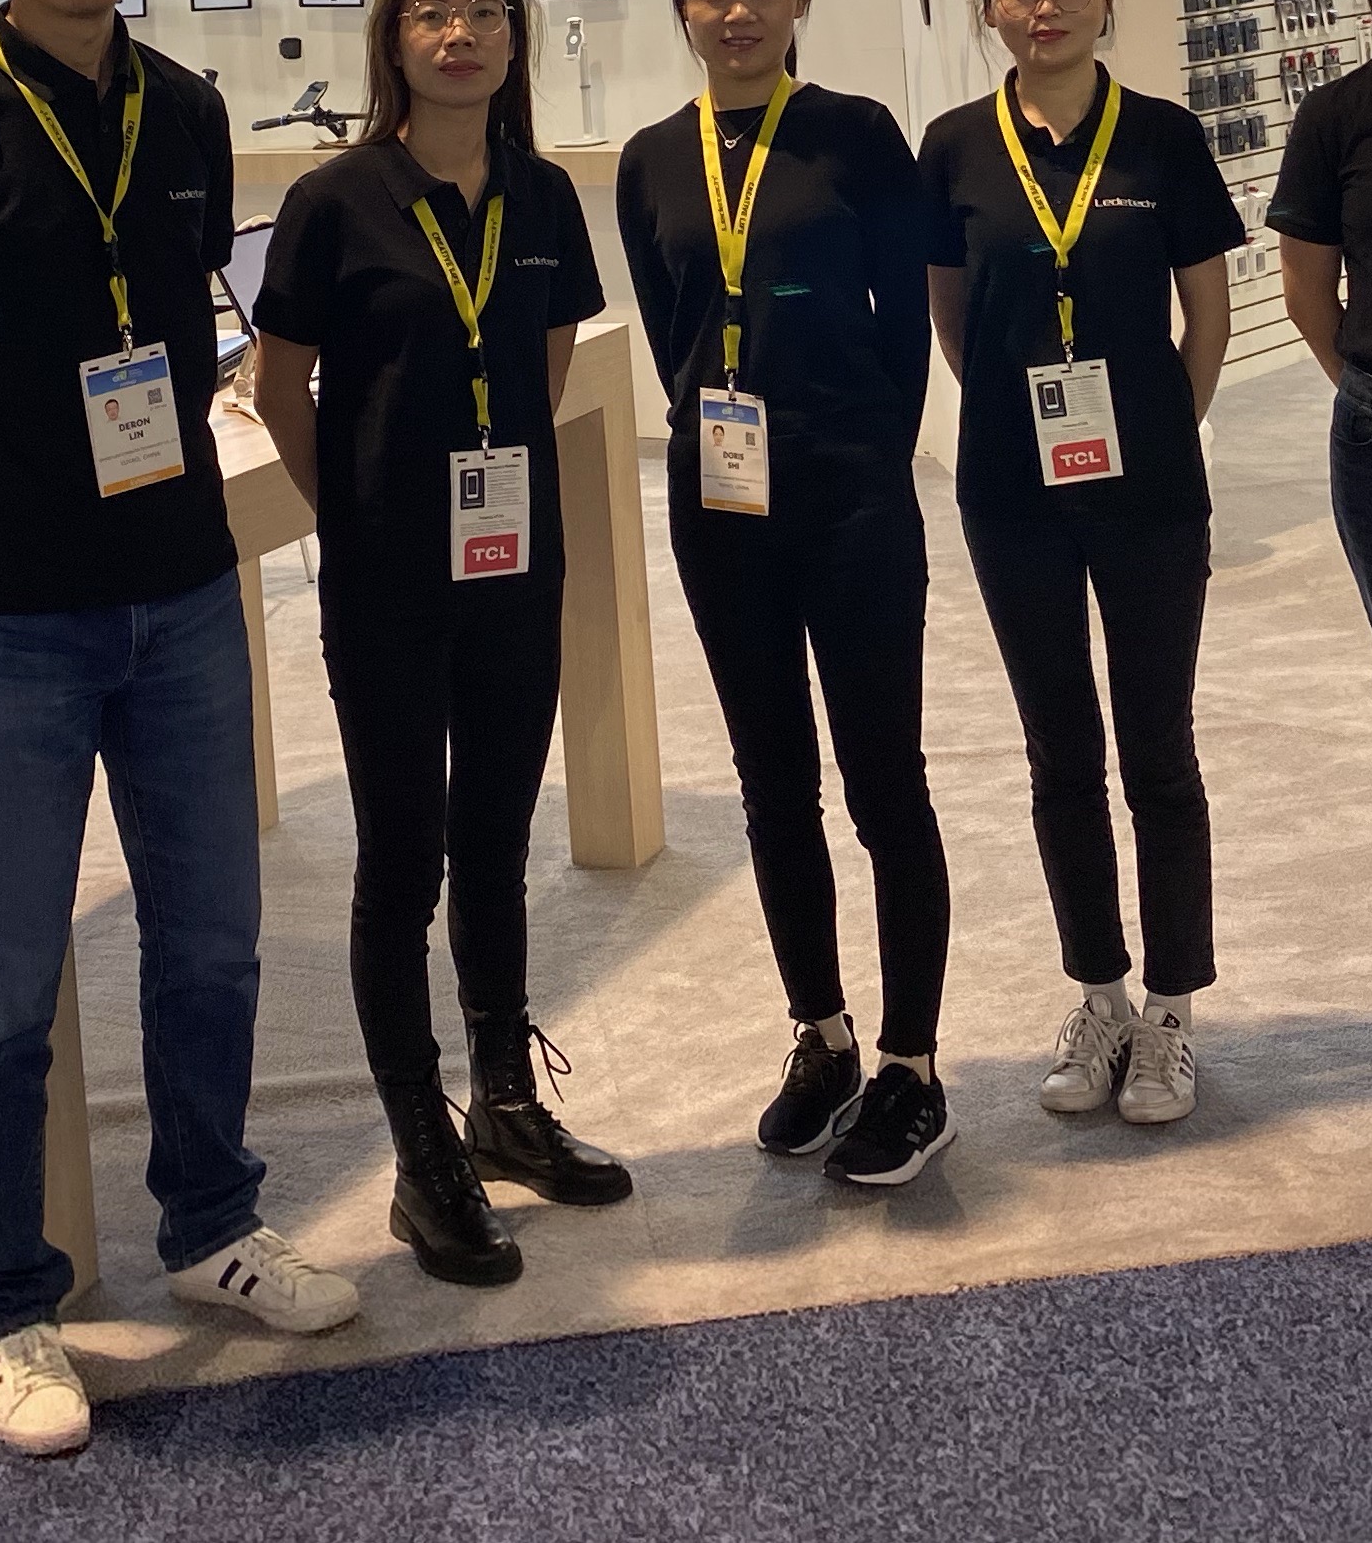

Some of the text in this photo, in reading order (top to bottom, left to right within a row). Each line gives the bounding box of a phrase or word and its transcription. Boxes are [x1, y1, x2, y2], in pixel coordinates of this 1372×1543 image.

[118, 416, 152, 433] DERON
[128, 429, 145, 442] LIN
[1059, 451, 1102, 468] TCL
[471, 545, 511, 562] TCL
